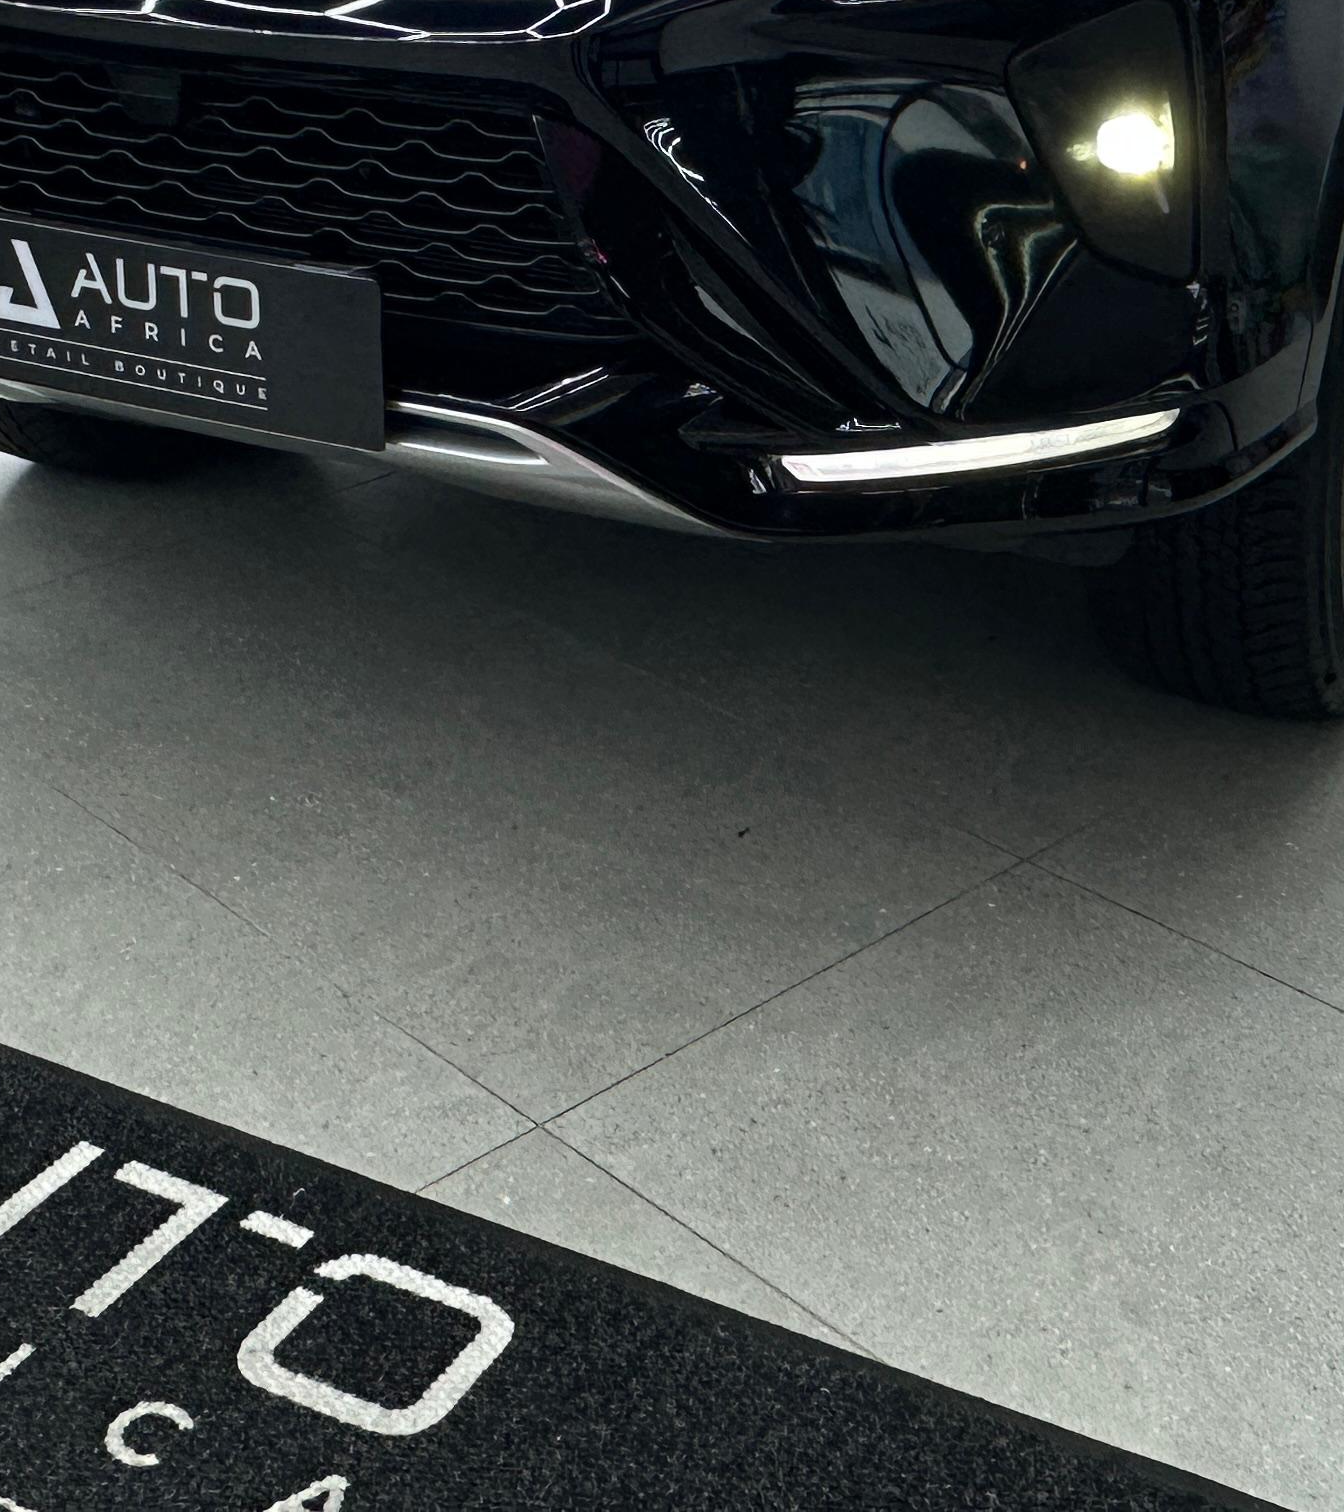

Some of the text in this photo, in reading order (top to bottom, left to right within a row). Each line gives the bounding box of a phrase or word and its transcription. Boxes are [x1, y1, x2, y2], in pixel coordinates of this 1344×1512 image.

[71, 252, 260, 330] AUTO
[74, 309, 262, 361] AFRICA
[114, 360, 268, 401] BOUTIQUE
